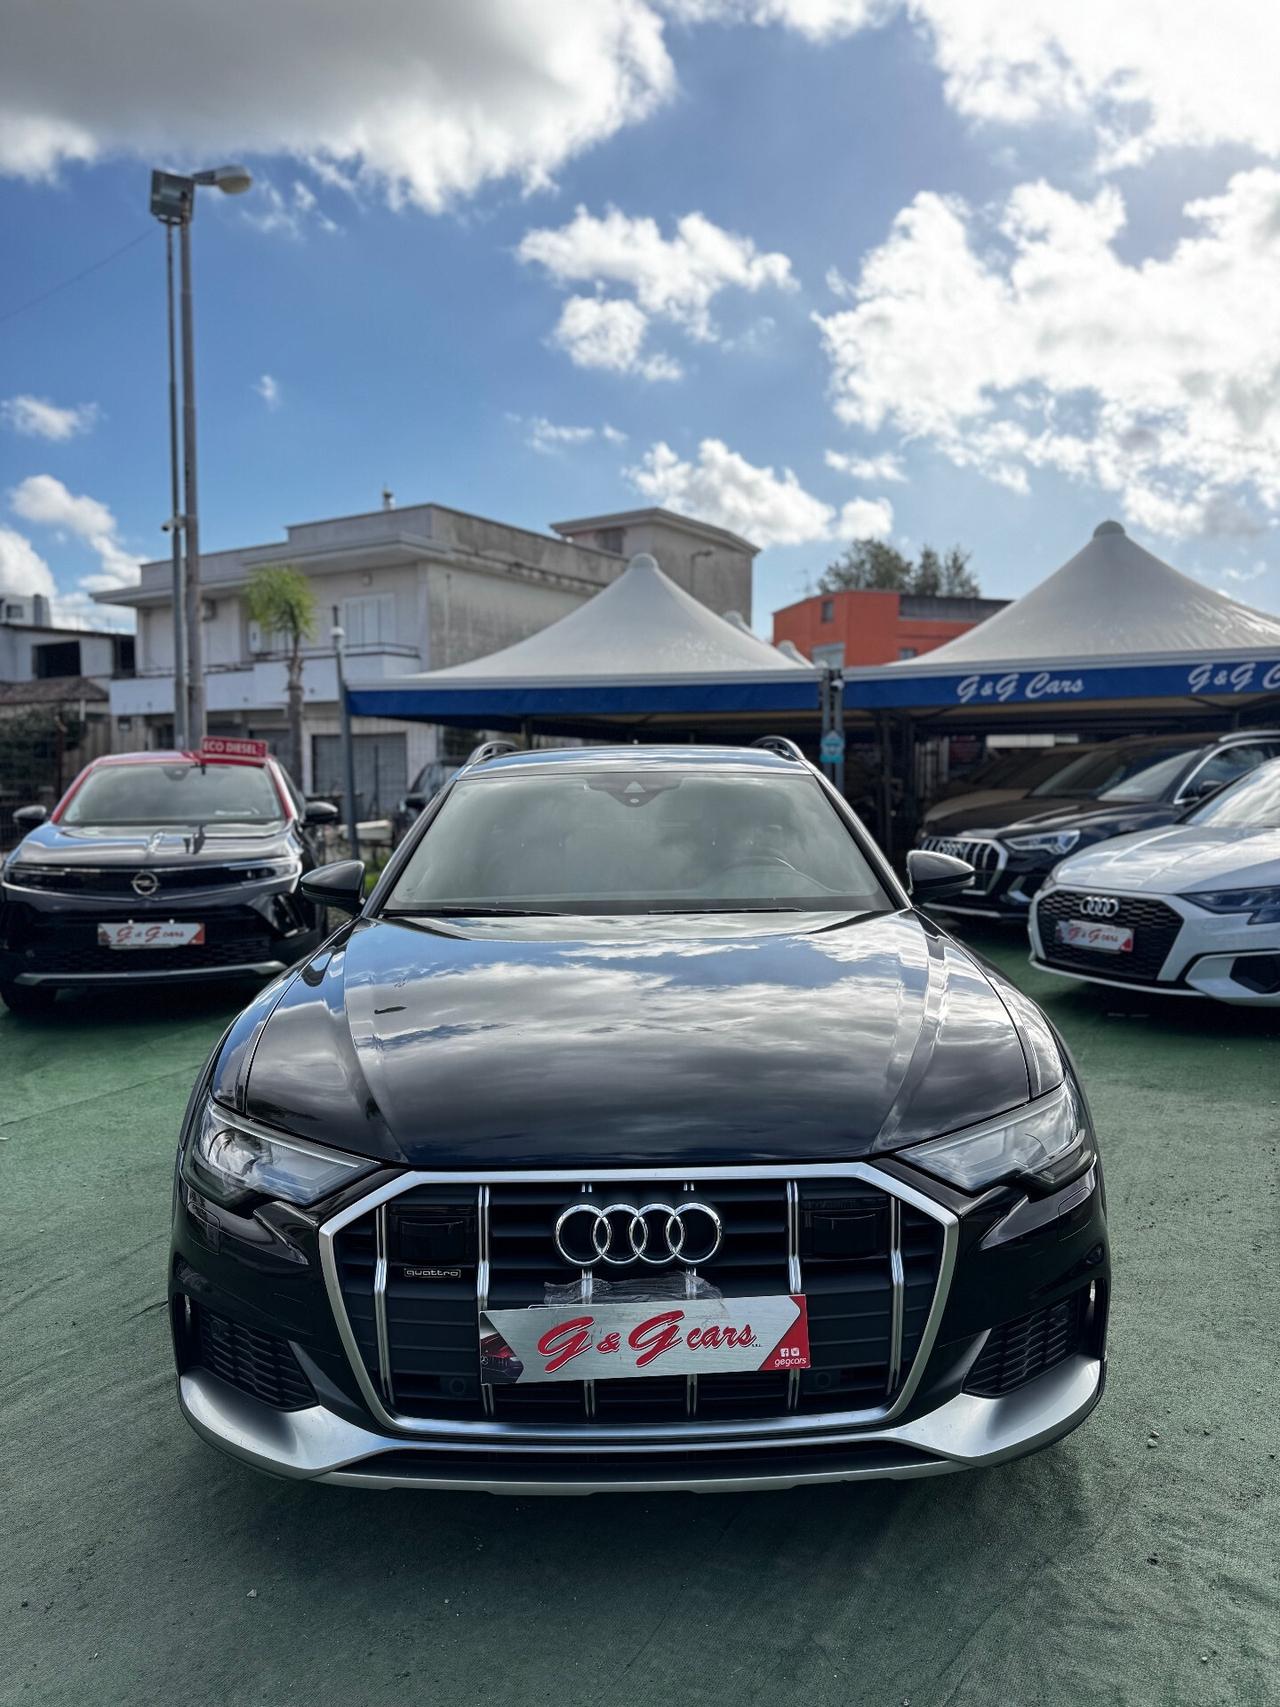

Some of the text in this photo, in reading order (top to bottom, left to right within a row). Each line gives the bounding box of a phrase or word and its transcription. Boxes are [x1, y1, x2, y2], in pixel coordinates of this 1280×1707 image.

[1025, 672, 1084, 699] Cars
[204, 741, 257, 755] ECO DIESEL
[406, 1269, 459, 1277] quattro
[685, 1323, 758, 1351] cars
[774, 1357, 808, 1368] gegcars
